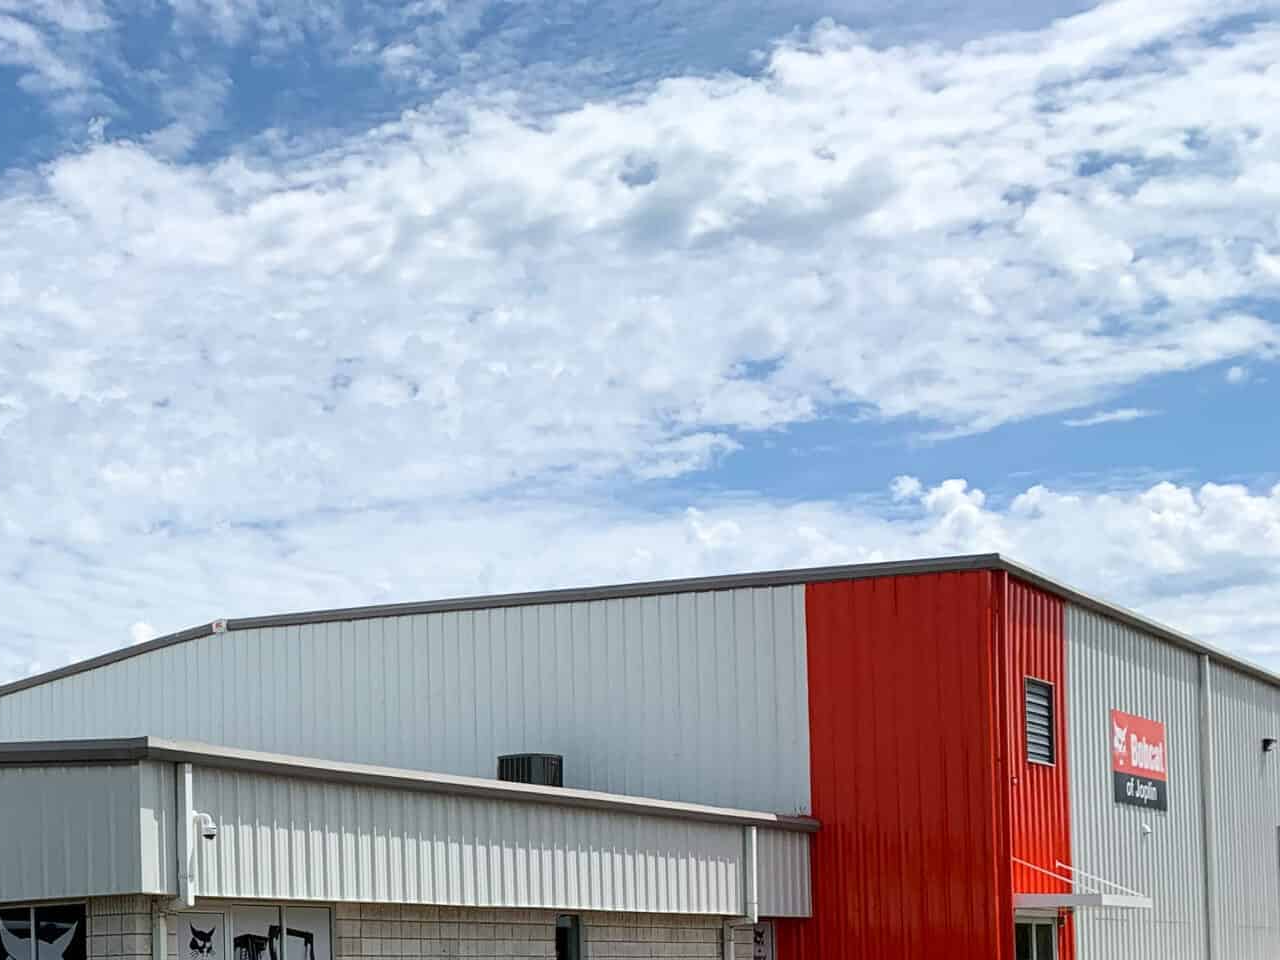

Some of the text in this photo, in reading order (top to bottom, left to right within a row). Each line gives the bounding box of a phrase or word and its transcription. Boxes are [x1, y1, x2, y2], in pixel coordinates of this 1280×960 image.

[1130, 732, 1164, 773] Bobcat
[1126, 777, 1159, 804] of Joplin
